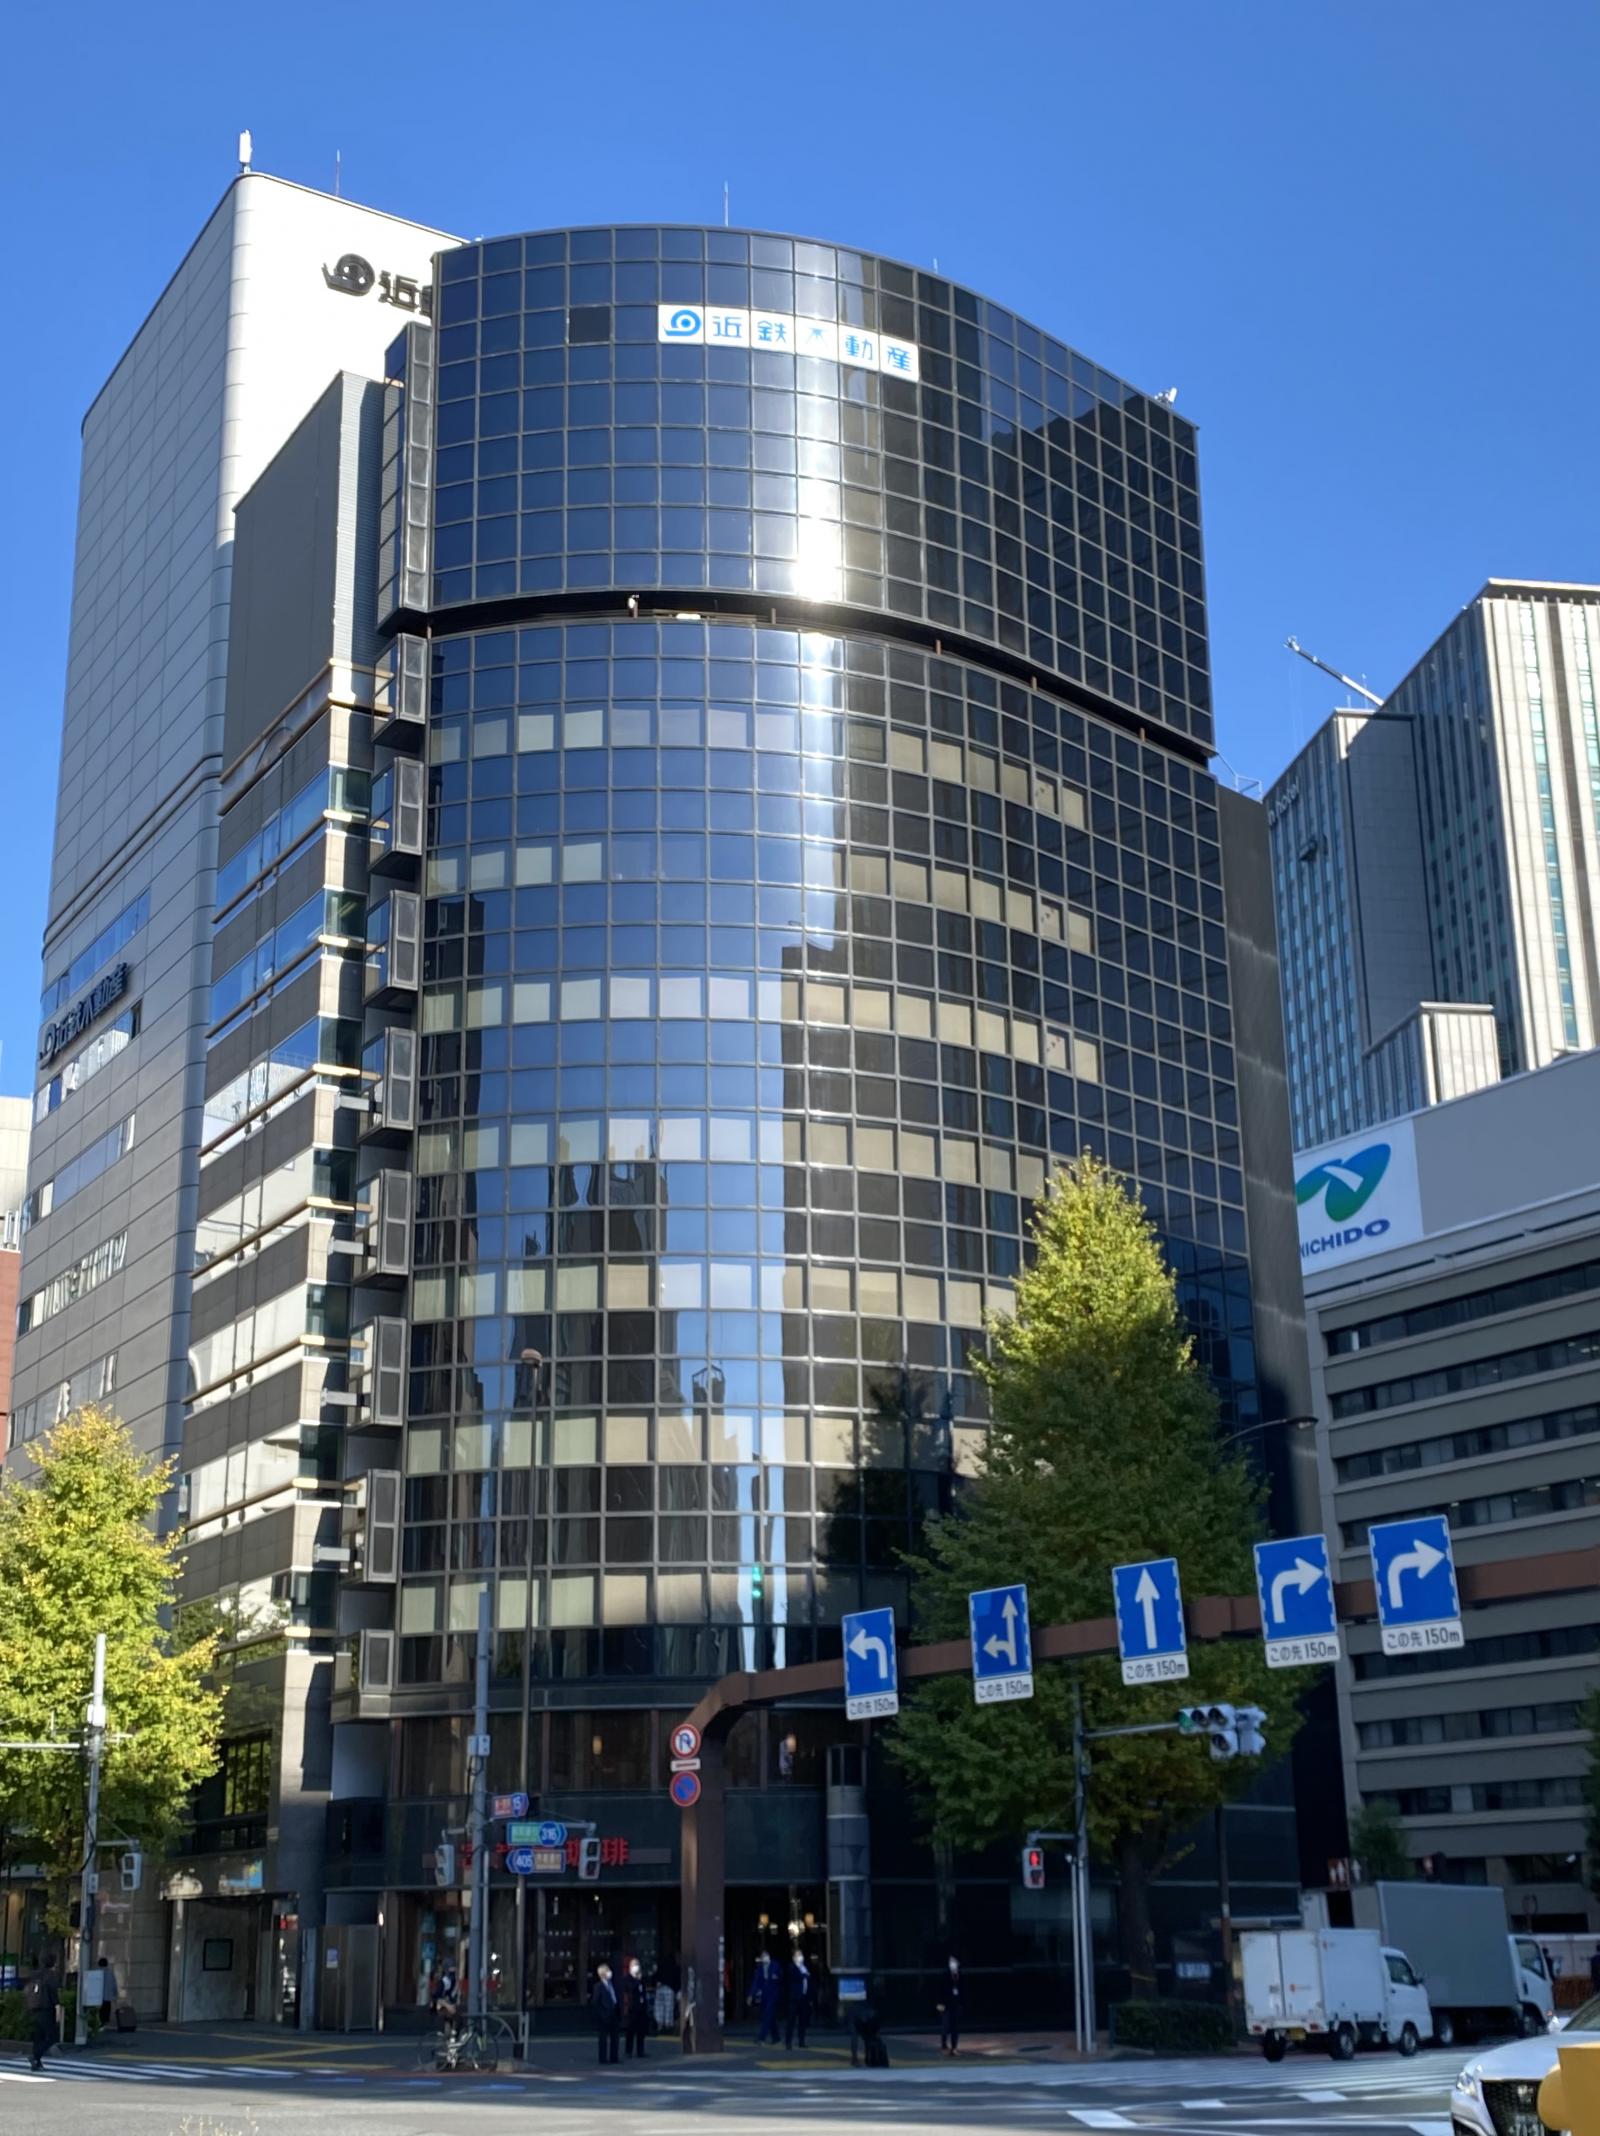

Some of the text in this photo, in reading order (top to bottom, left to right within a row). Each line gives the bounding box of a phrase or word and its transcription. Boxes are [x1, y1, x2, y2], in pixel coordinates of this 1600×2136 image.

[378, 270, 432, 318] 近
[712, 316, 912, 373] 近鉄不動産
[1387, 1626, 1460, 1650] この先150m
[1270, 1640, 1337, 1662] この先150m
[1127, 1659, 1187, 1680] この先150m
[541, 1827, 558, 1841] 316
[515, 1853, 533, 1868] 405
